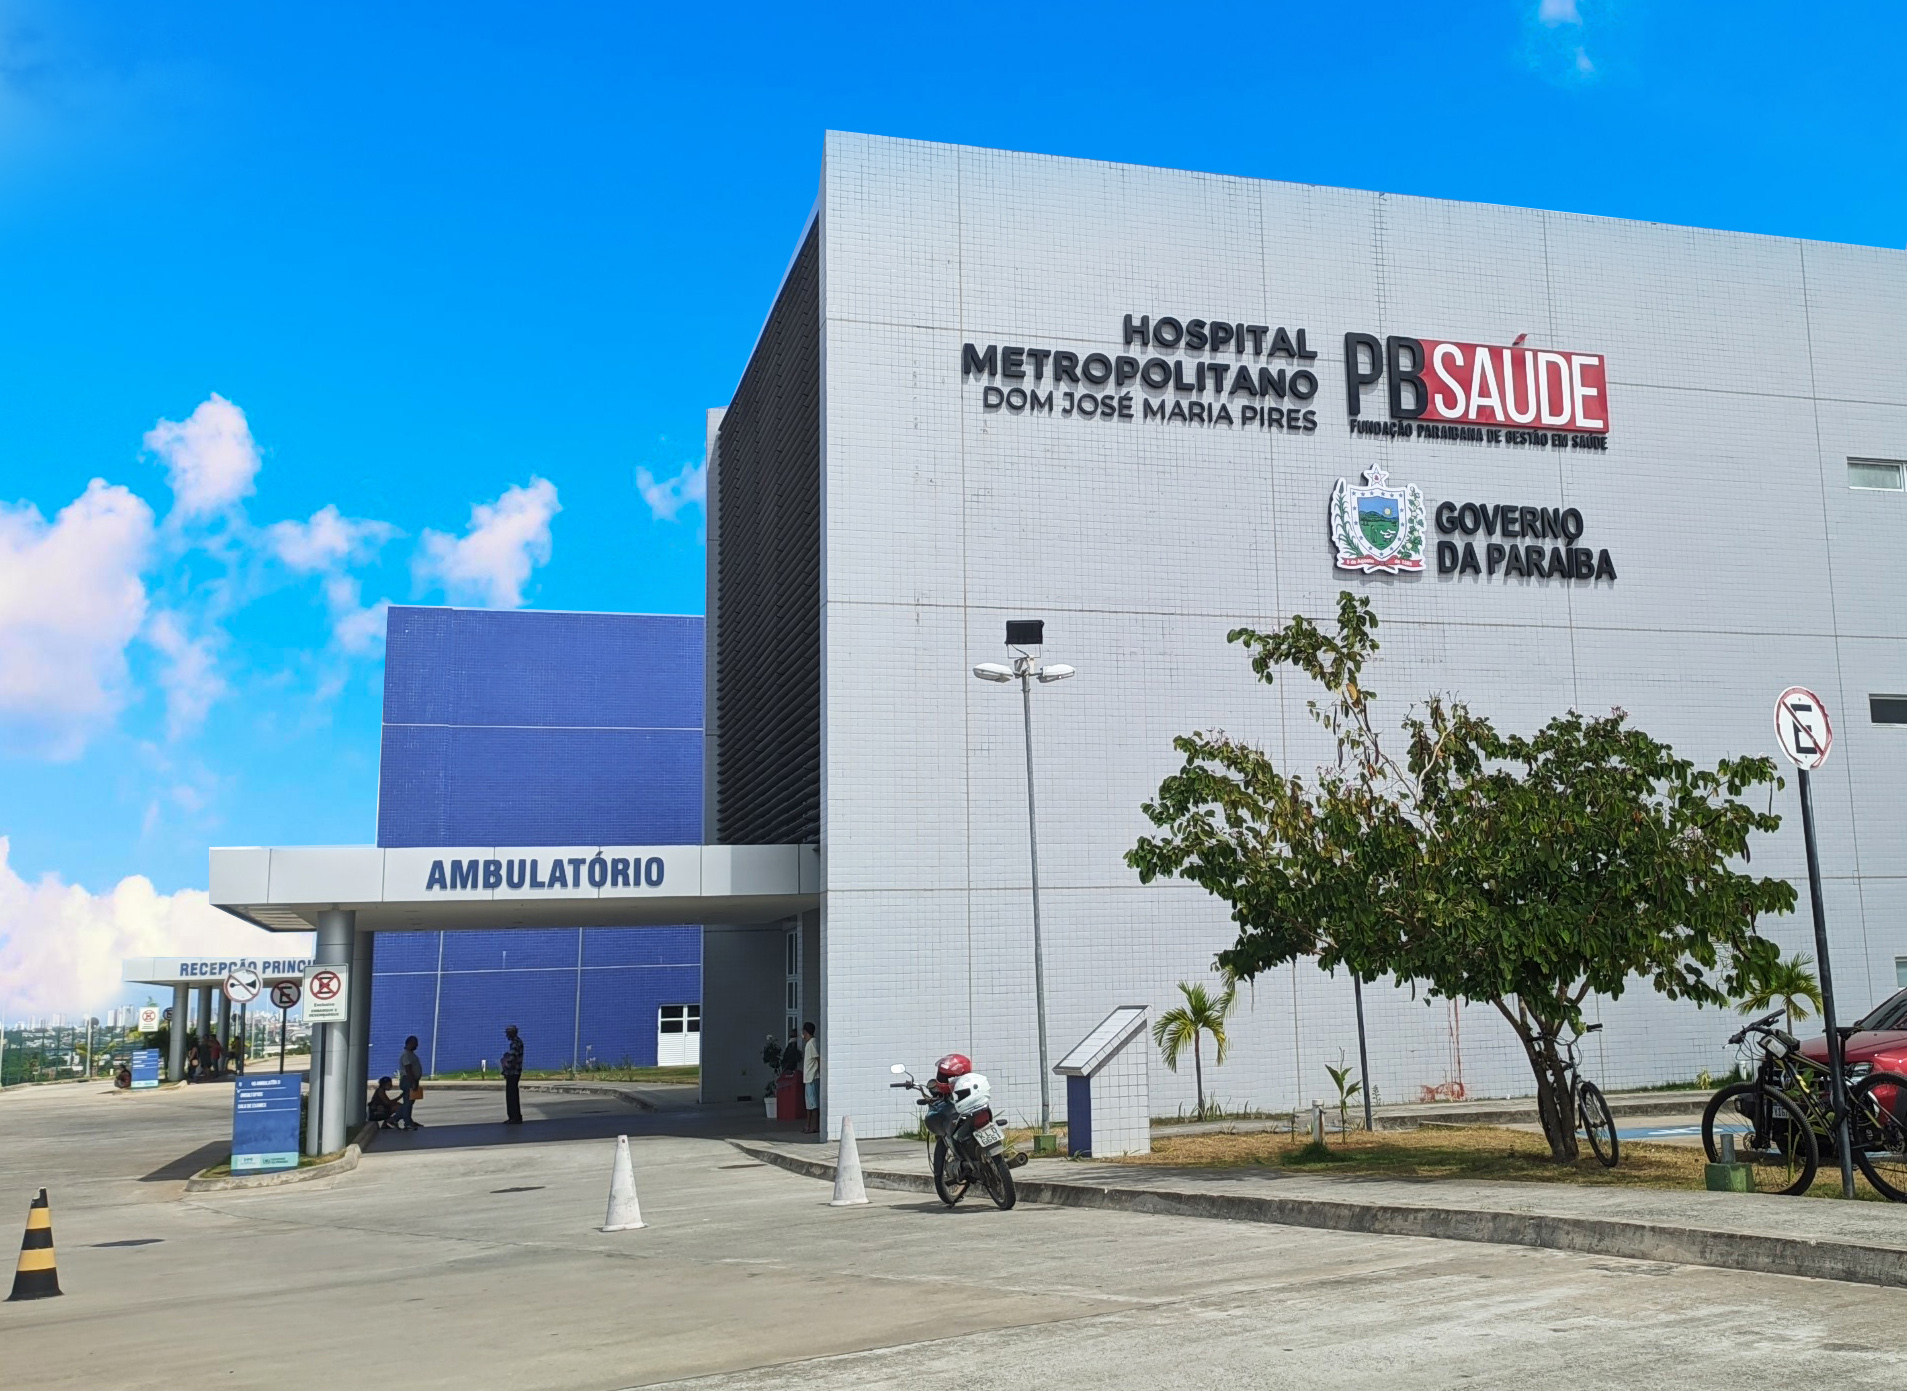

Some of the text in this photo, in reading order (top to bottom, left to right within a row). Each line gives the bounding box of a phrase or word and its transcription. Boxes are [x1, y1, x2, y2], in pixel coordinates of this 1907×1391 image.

[1123, 313, 1318, 360] HOSPITAL
[962, 343, 1318, 400] METROPOLITANO
[983, 385, 1318, 431] DOM JOSÉ MARIA PIRES
[1350, 418, 1608, 450] FUNDAÇÃO PARAIBANA DE GESTÃO EM SAÚDE
[1435, 501, 1584, 540] GOVERNO
[1437, 538, 1617, 581] DA PARAÍBA
[425, 850, 665, 891] AMBULATÓRIO
